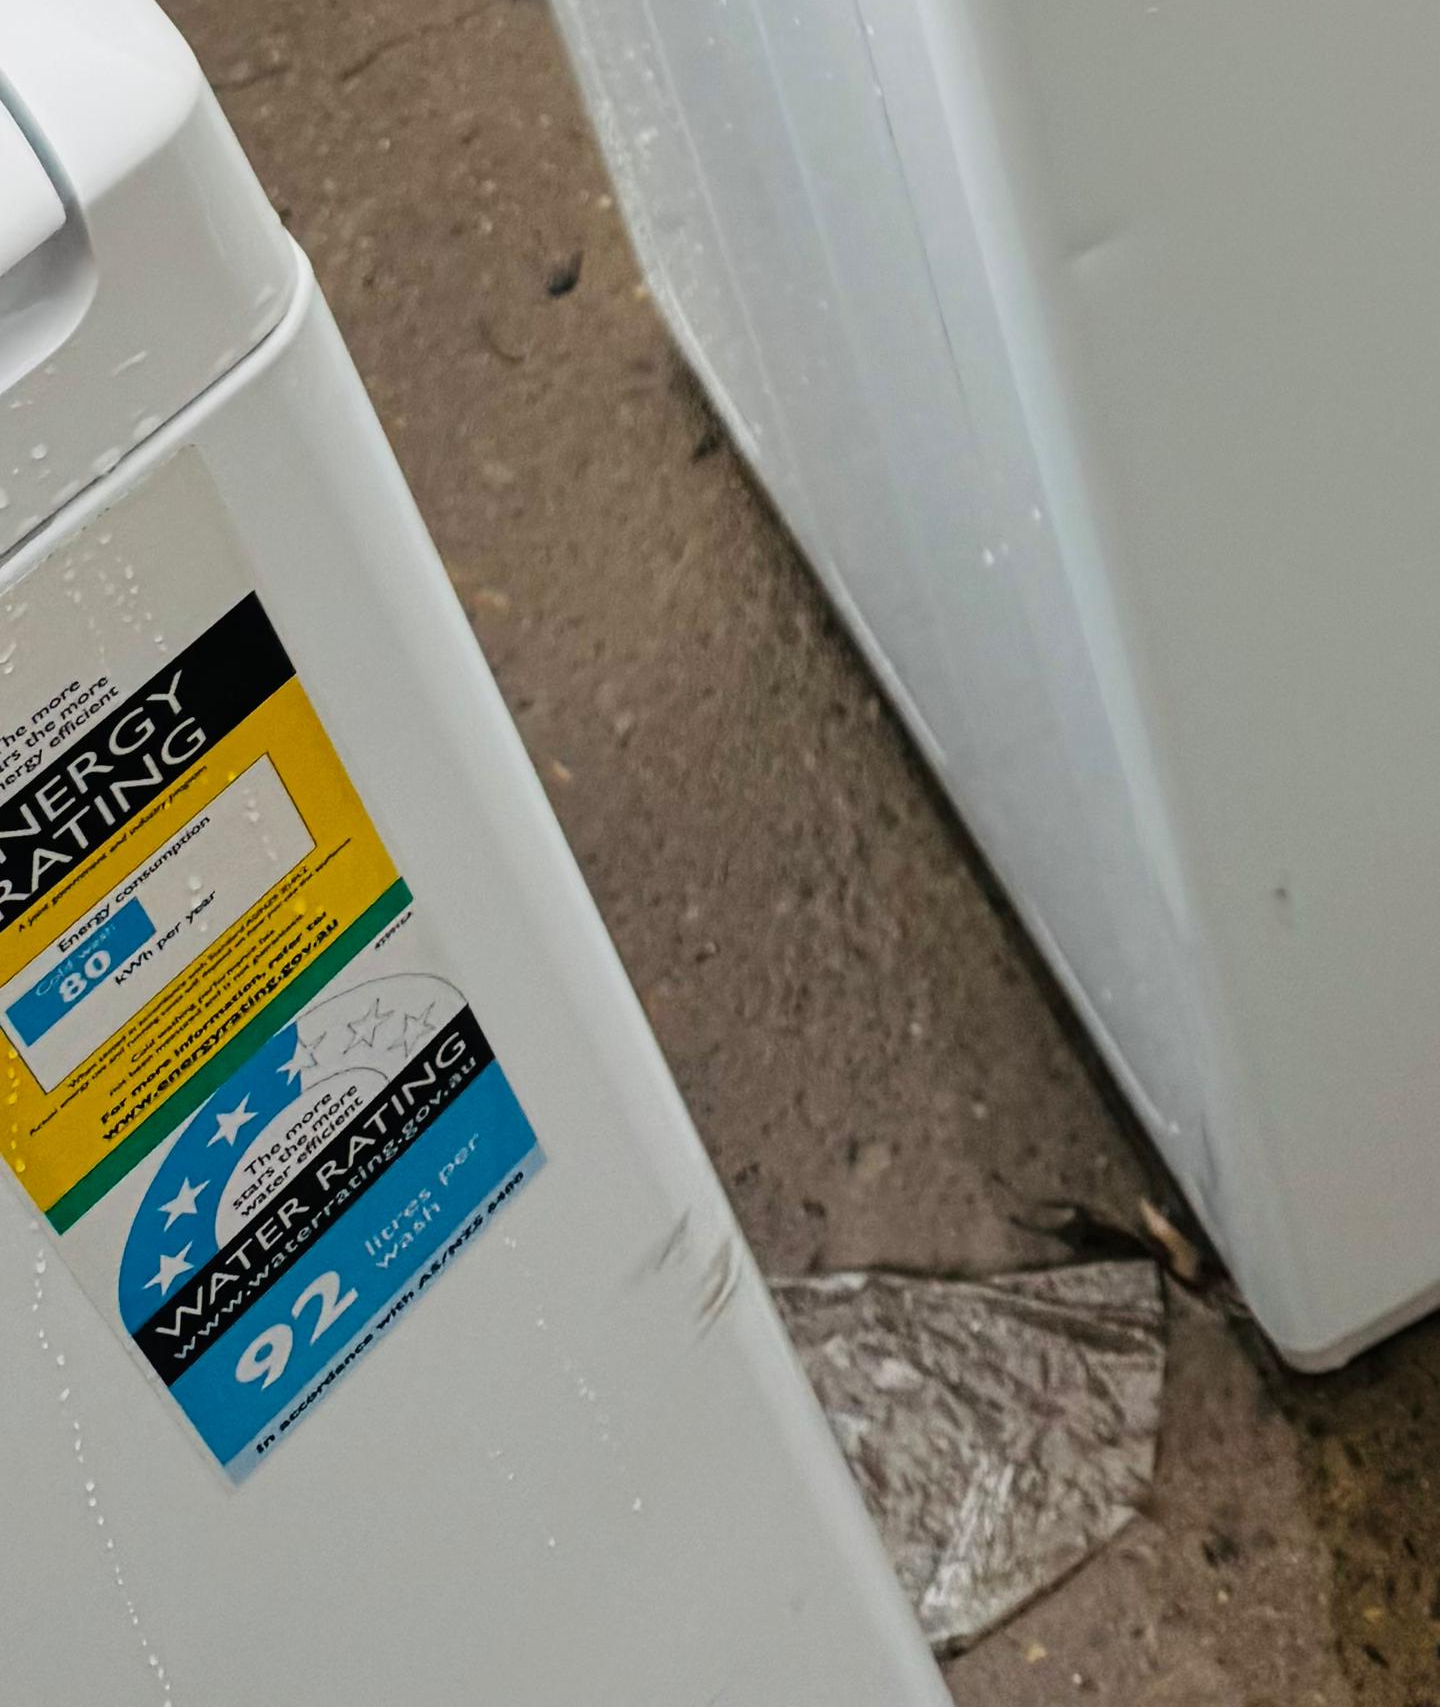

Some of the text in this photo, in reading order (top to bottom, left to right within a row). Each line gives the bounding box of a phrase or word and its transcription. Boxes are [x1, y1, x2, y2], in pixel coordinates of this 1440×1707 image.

[0, 680, 81, 755] he more
[25, 720, 56, 747] the
[60, 675, 109, 721] more
[50, 686, 119, 748] efficient
[57, 816, 210, 952] Energy consumption
[114, 890, 216, 985] kWh per year
[36, 923, 116, 996] Cold wash
[59, 950, 111, 1003] 80
[101, 1096, 128, 1125] For
[131, 1058, 173, 1096] more
[173, 971, 267, 1057] information,
[269, 932, 303, 969] refer
[102, 918, 339, 1140] www.energyrating.gov.au
[155, 1029, 468, 1338] WATER RATING
[233, 1085, 358, 1210] stars the more
[241, 1096, 364, 1217] water efficient
[244, 1093, 332, 1175] The more
[364, 1132, 481, 1257] litres per
[174, 1055, 478, 1359] www.waterrating.gov.au
[376, 1201, 442, 1270] wash
[235, 1270, 360, 1391] 92
[279, 1332, 375, 1432] accordance
[376, 1289, 415, 1330] with
